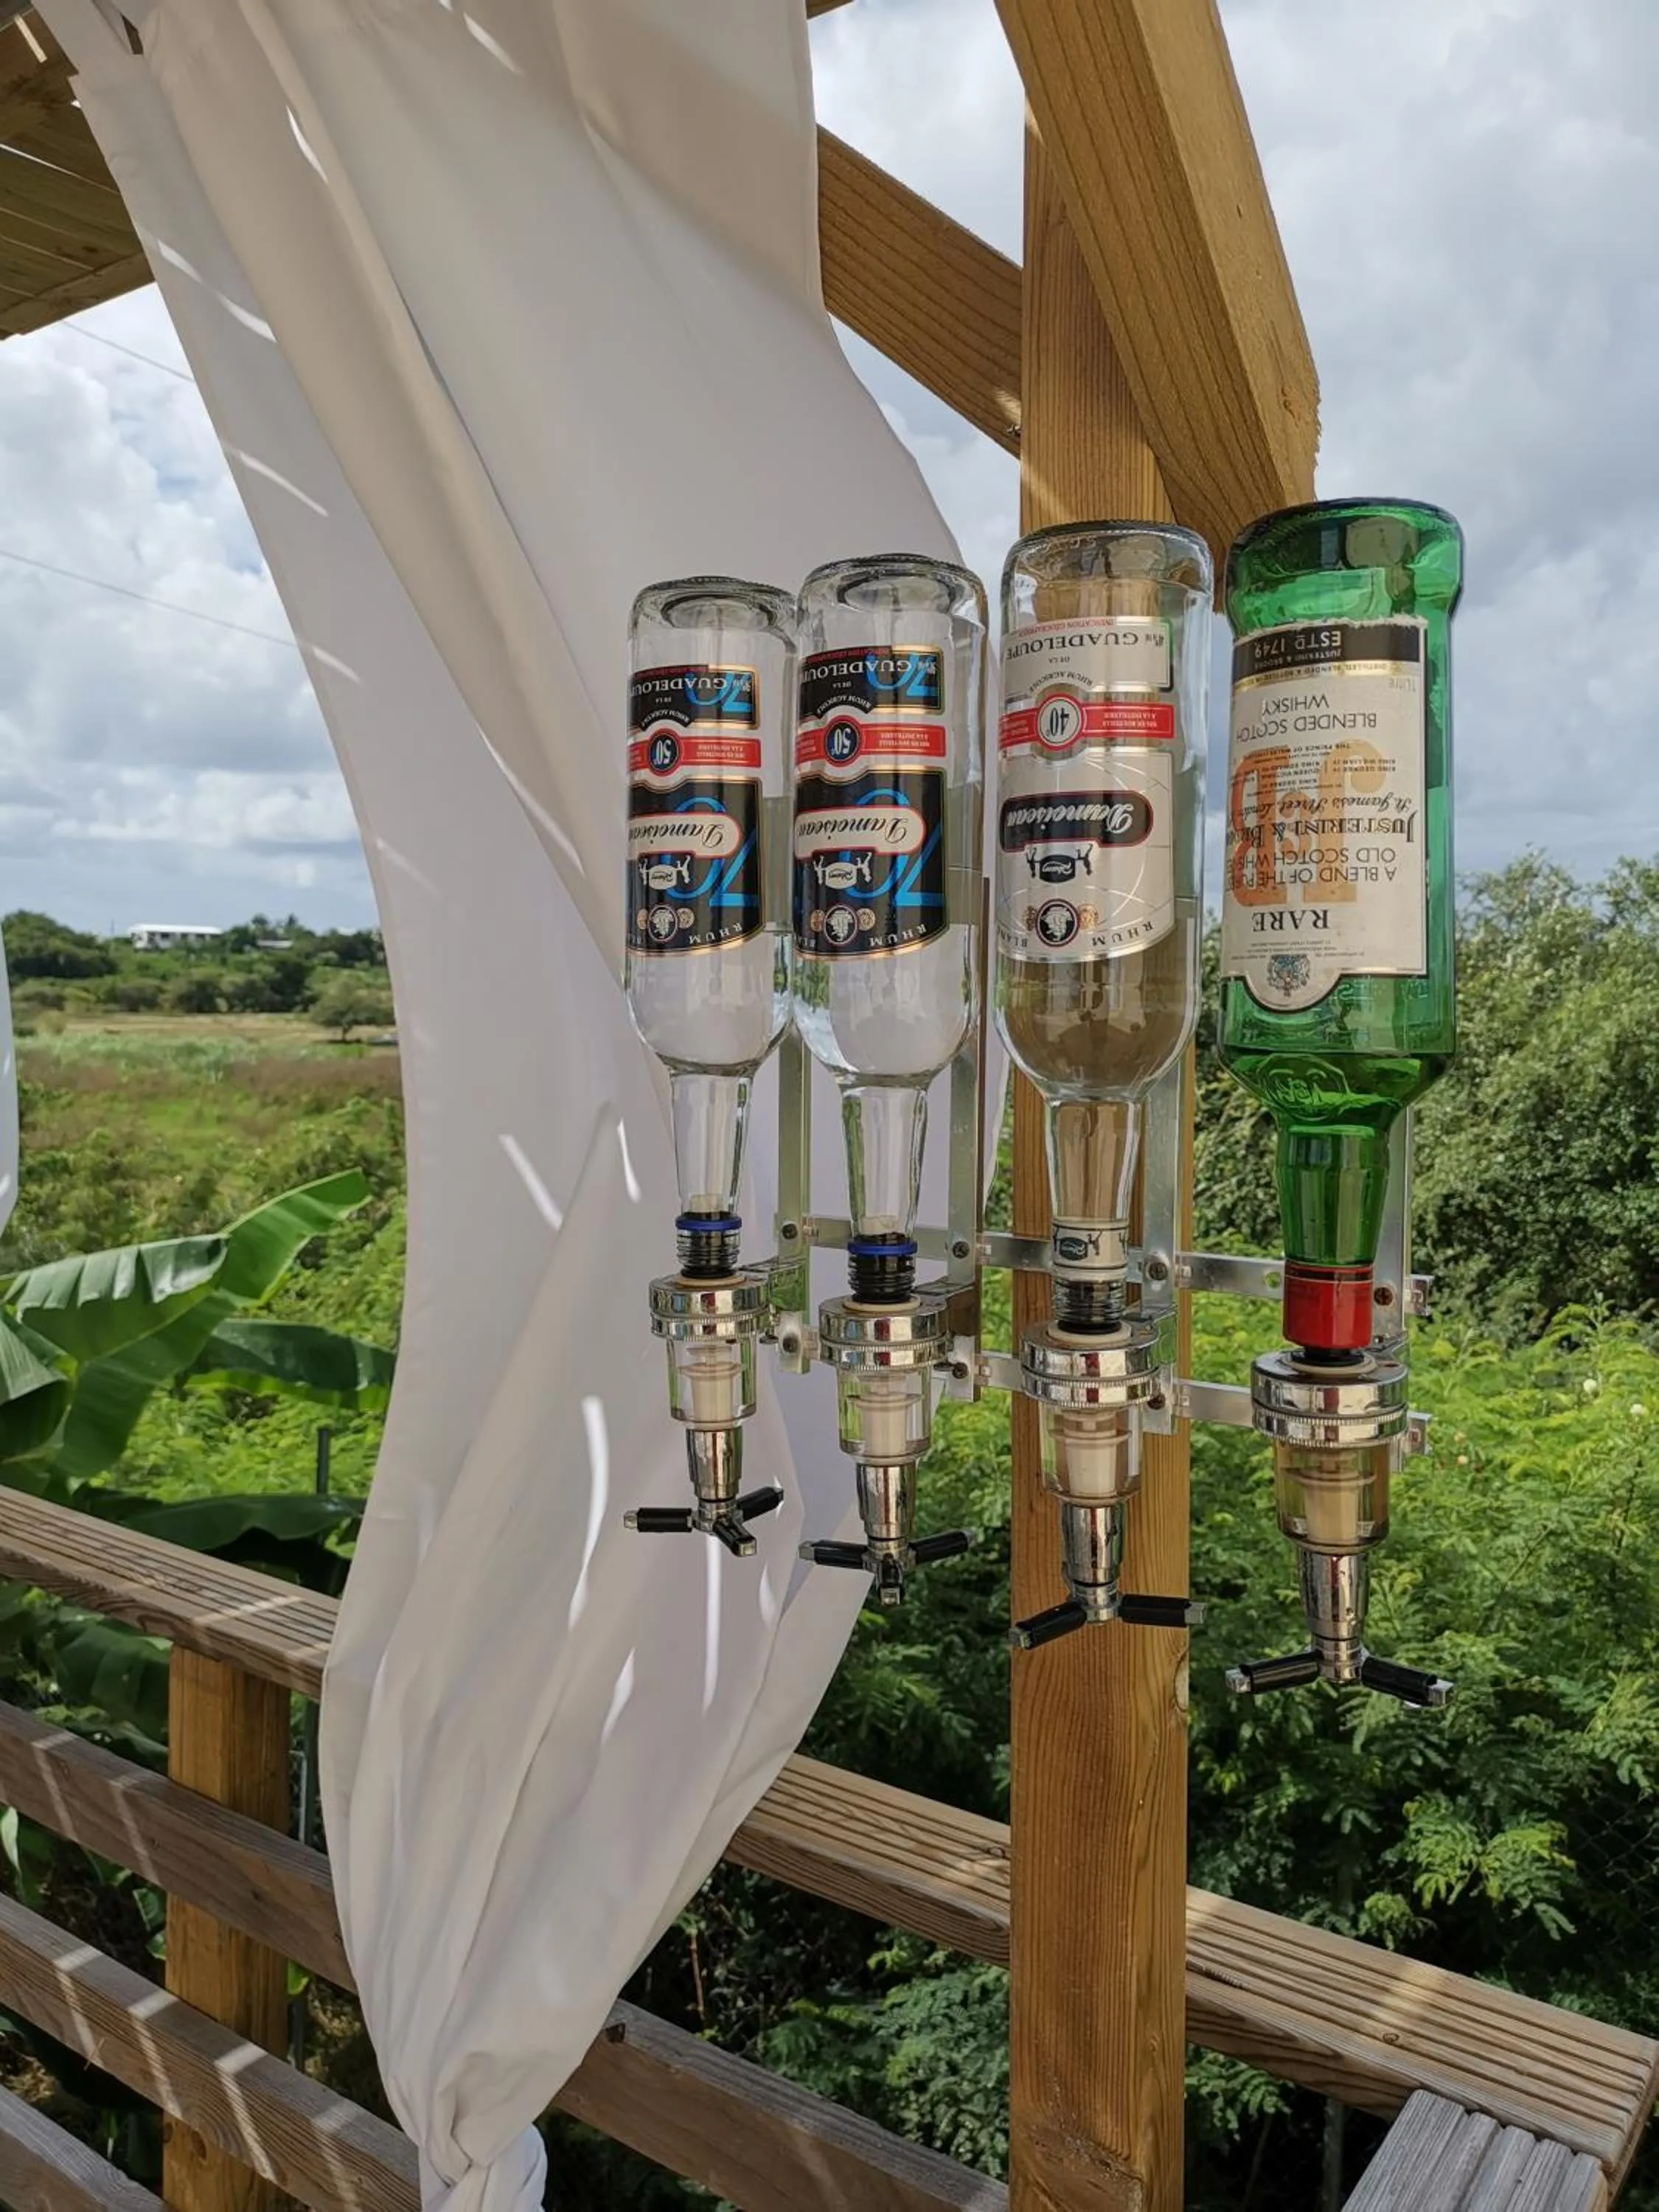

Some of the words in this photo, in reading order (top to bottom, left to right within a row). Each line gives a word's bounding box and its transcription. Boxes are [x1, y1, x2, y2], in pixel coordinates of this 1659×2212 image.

[1006, 633, 1139, 661] GUADELOUPE
[1067, 670, 1093, 686] RHUM
[1262, 694, 1330, 717] WHISKY
[1294, 712, 1377, 732] BLENDED
[1006, 802, 1134, 834] Damoiseau
[1294, 812, 1416, 842] JUSTERINI
[799, 818, 909, 844] Damoiseau
[1275, 850, 1349, 866] SCOTCH
[1356, 847, 1396, 863] OLD
[1288, 869, 1313, 885] OF
[1319, 866, 1379, 883] BLEND
[1385, 866, 1398, 882] A
[1251, 908, 1331, 933] RARE
[688, 922, 743, 945] RHUM
[869, 924, 926, 947] RHUM
[1091, 921, 1154, 947] RHUM
